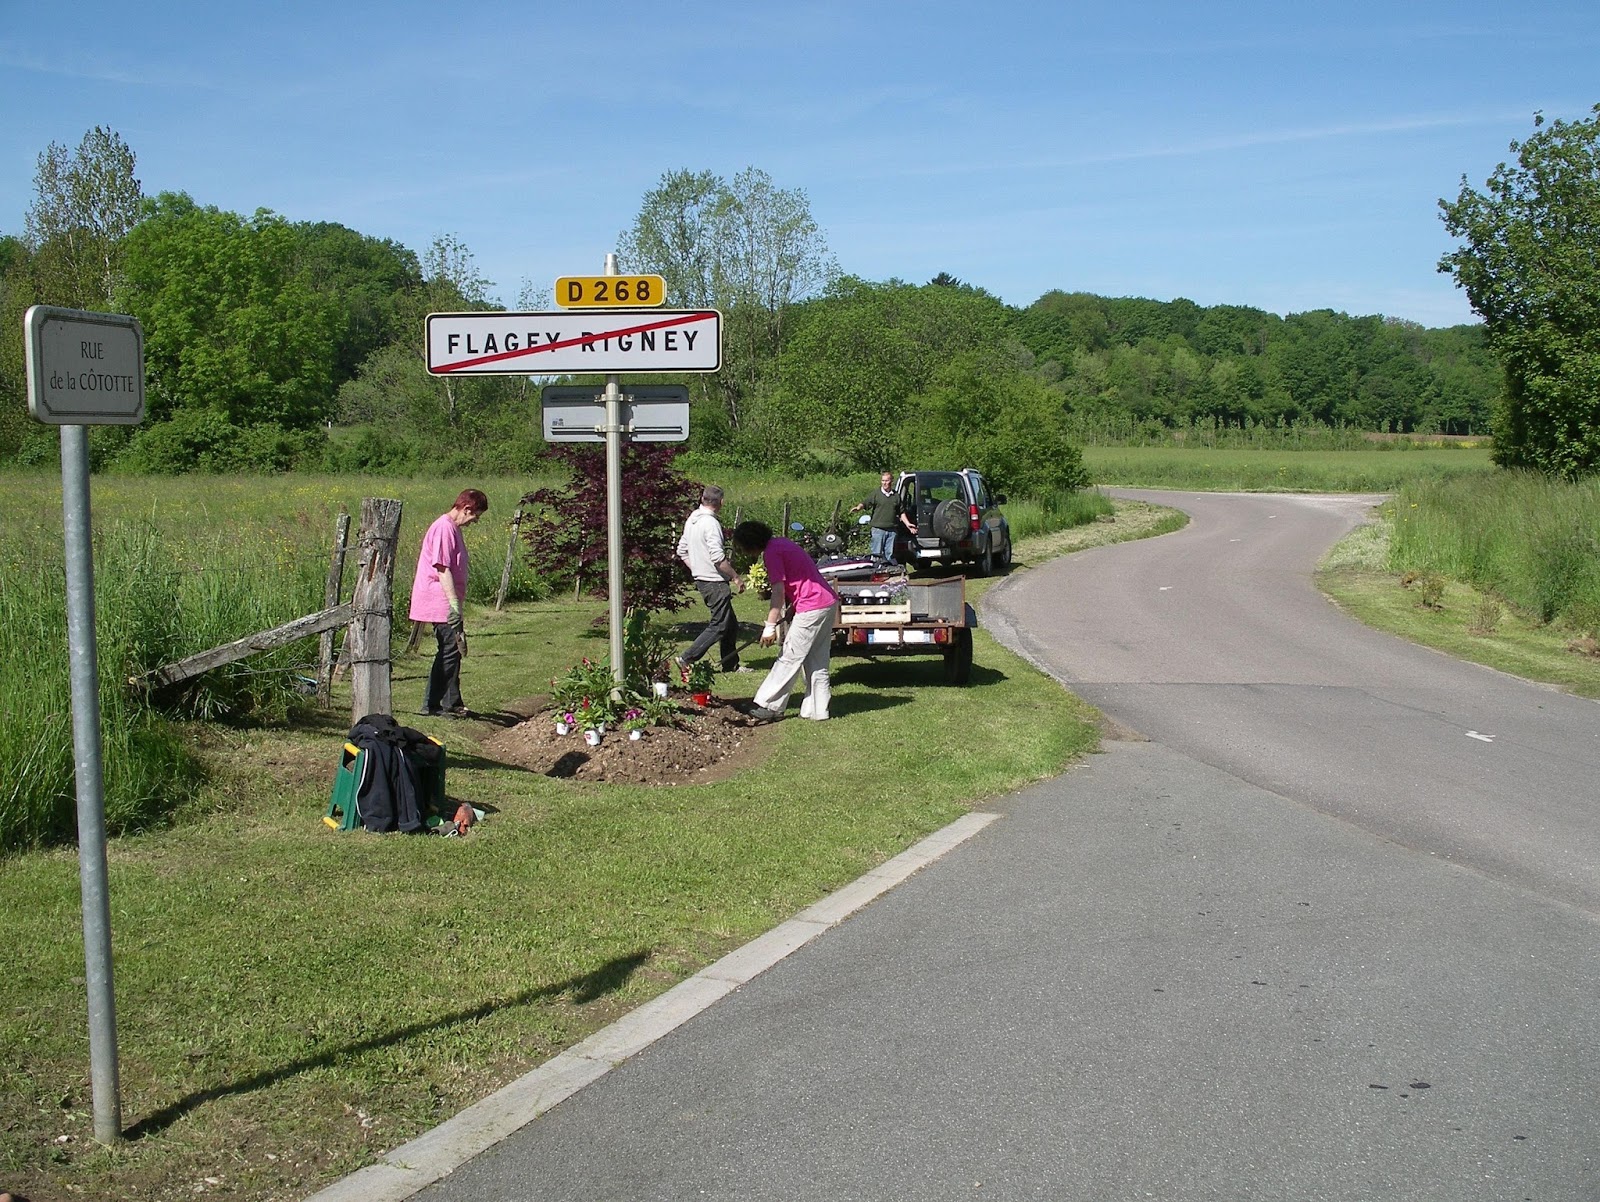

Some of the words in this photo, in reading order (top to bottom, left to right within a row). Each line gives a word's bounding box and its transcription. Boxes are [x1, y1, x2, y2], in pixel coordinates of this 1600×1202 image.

[568, 281, 583, 302] D
[594, 280, 650, 302] 268
[81, 341, 104, 360] RUE
[448, 331, 561, 355] FLAGEY
[581, 330, 699, 352] RIGNEY
[50, 370, 63, 390] de
[67, 371, 76, 391] la
[80, 368, 134, 393] CÔTOTTE
